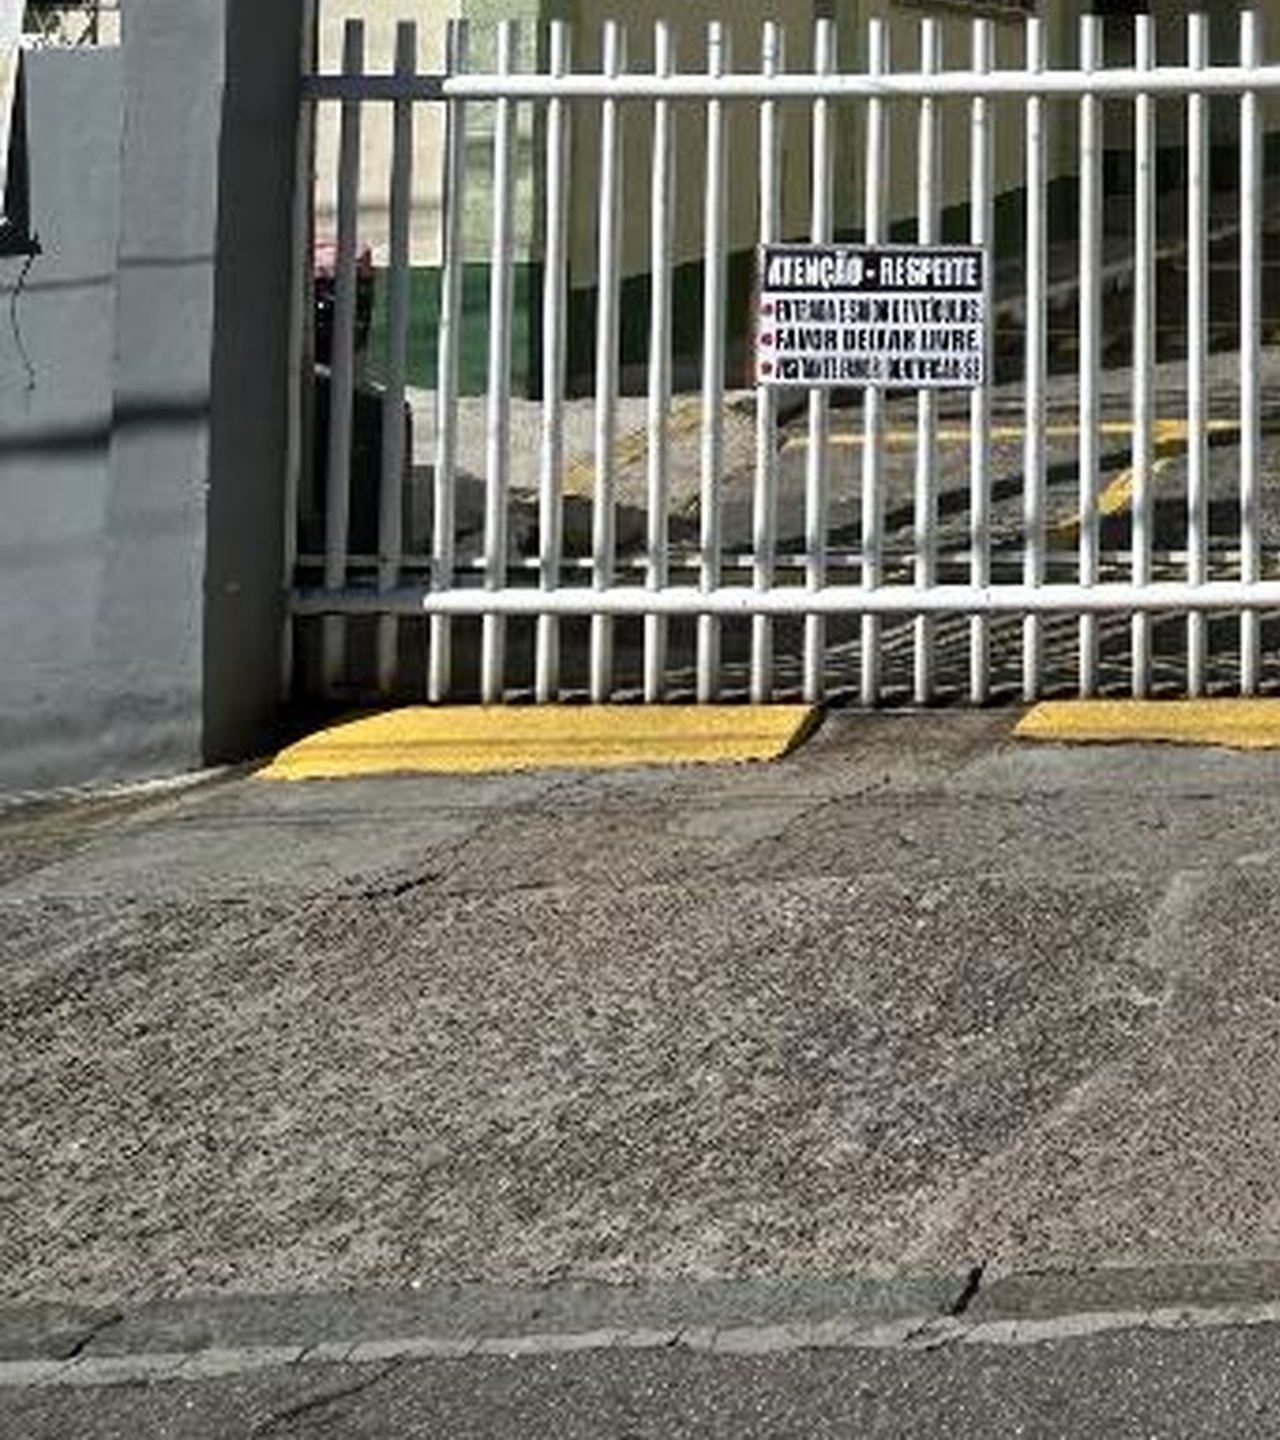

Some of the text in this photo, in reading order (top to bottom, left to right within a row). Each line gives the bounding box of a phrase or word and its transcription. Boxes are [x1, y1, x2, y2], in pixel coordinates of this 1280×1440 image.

[768, 251, 864, 290] ATENÇÃO
[880, 256, 978, 287] RESPEITE
[775, 329, 838, 351] FAVOR
[842, 329, 917, 351] DEIXAR
